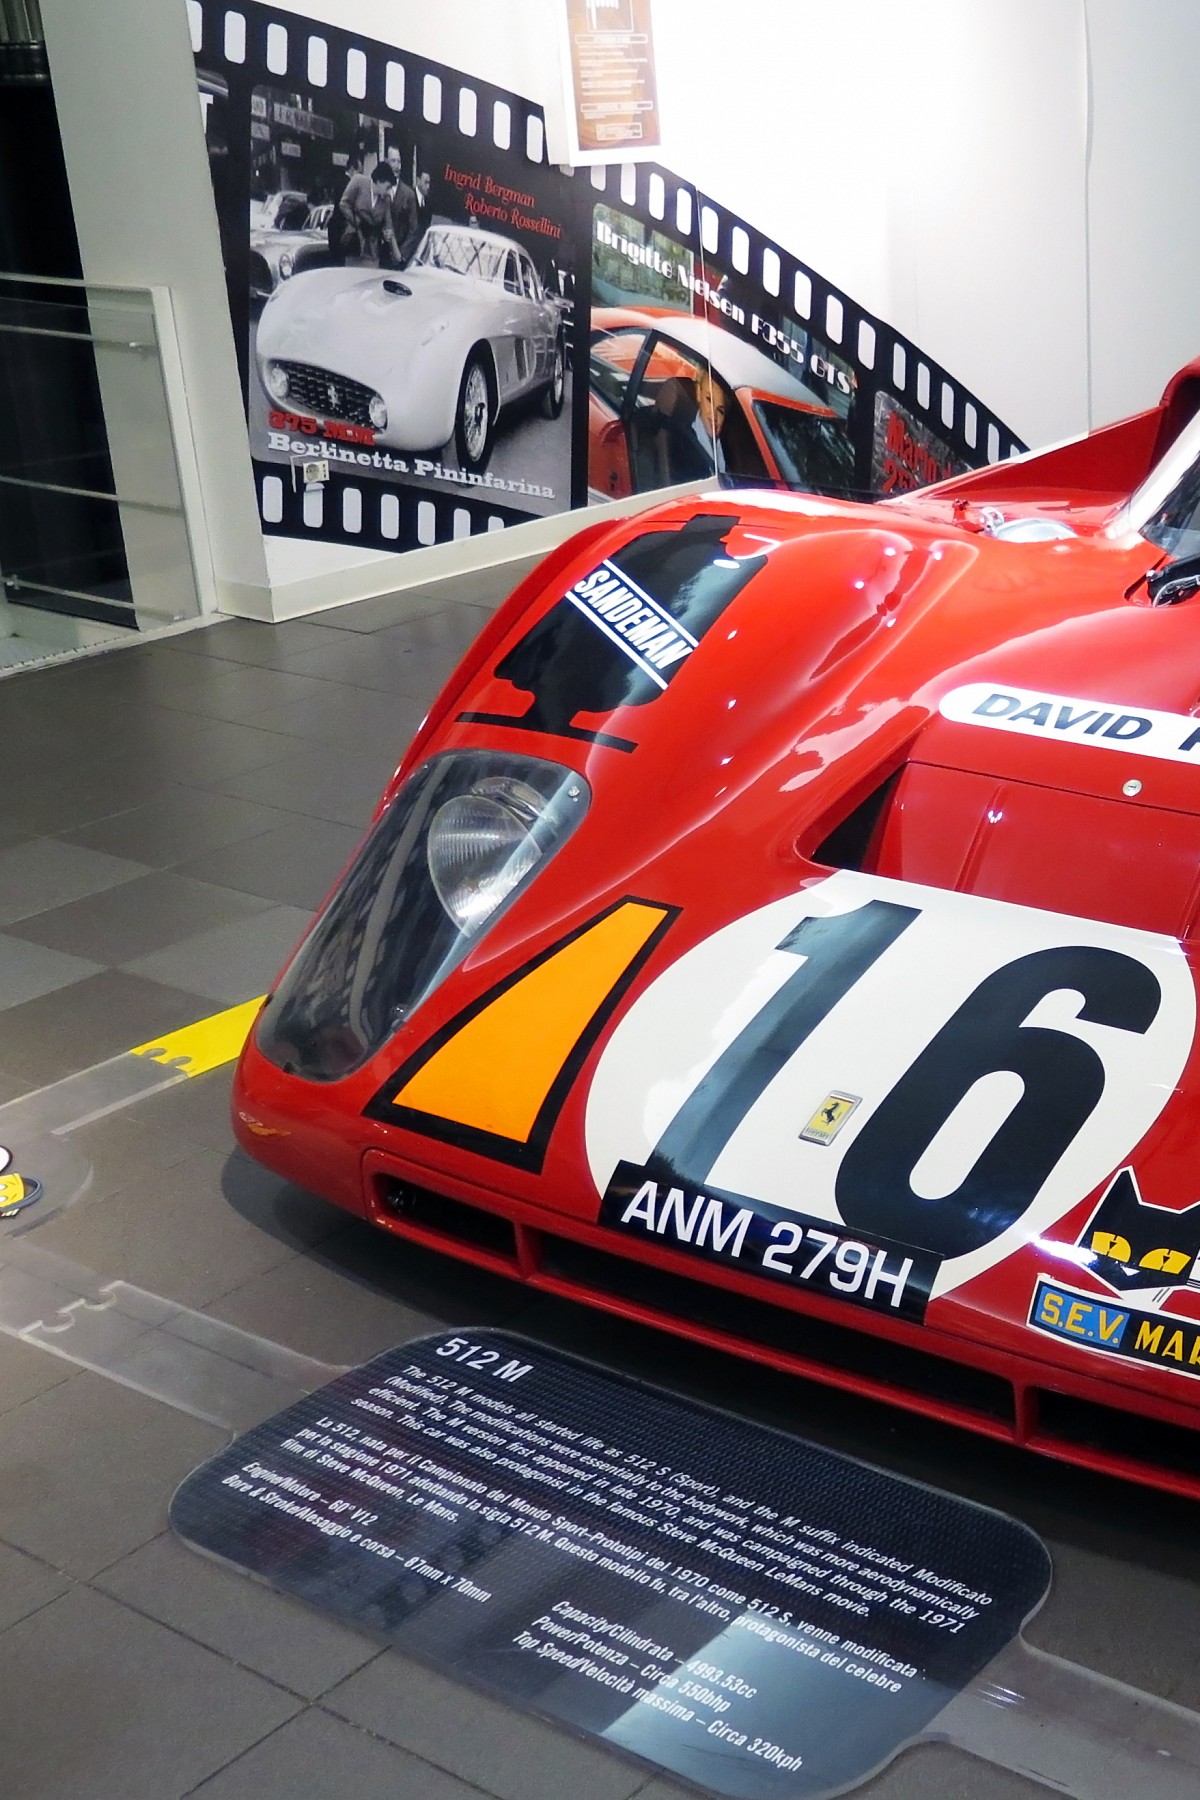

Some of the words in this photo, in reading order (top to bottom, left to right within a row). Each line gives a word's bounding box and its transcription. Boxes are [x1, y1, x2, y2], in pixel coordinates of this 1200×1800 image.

[444, 164, 481, 190] Ingrid
[485, 175, 535, 208] Bergman
[465, 192, 507, 221] Roberto
[511, 207, 561, 239] Rossellini
[597, 221, 674, 278] Brigitte
[677, 264, 745, 326] Nielsen
[751, 314, 805, 364] F355
[267, 432, 410, 474] Berlinetta
[413, 458, 556, 500] Pininfarina
[323, 421, 377, 446] MM
[573, 569, 695, 670] SANDEMAN
[973, 693, 1154, 741] DAVID
[650, 900, 1162, 1261] 16
[621, 1180, 756, 1260] ANM
[762, 1220, 914, 1308] 279H
[434, 1336, 499, 1369] 512
[491, 1358, 533, 1382] M
[1041, 1292, 1121, 1344] S.E.V.
[279, 1437, 305, 1453] film
[301, 1448, 321, 1459] di
[315, 1452, 350, 1473] Steve
[347, 1466, 405, 1499] McQueen,
[404, 1491, 424, 1505] Le
[349, 1397, 393, 1419] season.
[395, 1413, 425, 1429] This
[421, 1426, 446, 1438] car
[443, 1434, 471, 1448] was
[466, 1445, 497, 1459] also
[491, 1456, 570, 1489] protagonist
[564, 1483, 583, 1496] in
[581, 1490, 607, 1505] the
[604, 1500, 658, 1526] famous
[655, 1521, 697, 1543] Steve
[695, 1537, 765, 1571] McQueen
[763, 1565, 823, 1595] LeMans
[821, 1591, 869, 1616] movie.
[349, 1507, 378, 1525] V12
[367, 1386, 420, 1411] efficient.
[420, 1405, 447, 1421] The
[444, 1416, 465, 1427] M
[460, 1423, 507, 1445] version
[504, 1440, 536, 1457] first
[530, 1453, 597, 1481] appeared
[591, 1475, 610, 1488] in
[608, 1482, 638, 1499] late
[637, 1494, 680, 1519] 1970,
[680, 1514, 715, 1530] and
[711, 1525, 741, 1542] was
[740, 1538, 832, 1578] campaigned
[828, 1572, 888, 1602] through
[888, 1596, 916, 1613] the
[917, 1609, 965, 1633] 1971
[401, 1363, 426, 1378] The
[424, 1374, 457, 1389] 512
[452, 1385, 473, 1396] M
[468, 1392, 516, 1414] models
[513, 1411, 538, 1422] all
[532, 1418, 583, 1440] started
[578, 1435, 604, 1449] life
[622, 1453, 657, 1470] 512
[654, 1465, 671, 1475] S
[667, 1471, 720, 1498] (Sport),
[720, 1493, 755, 1509] and
[752, 1504, 778, 1519] the
[778, 1515, 801, 1527] M
[797, 1524, 840, 1544] suffix
[840, 1539, 914, 1572] indicated
[911, 1567, 992, 1604] Modificato
[446, 1398, 473, 1414] The
[467, 1409, 552, 1446] modifications
[548, 1441, 581, 1458] were
[578, 1454, 649, 1486] essentially
[644, 1479, 662, 1491] to
[659, 1485, 685, 1500] the
[681, 1494, 749, 1529] bodywork,
[750, 1522, 794, 1545] which
[792, 1539, 823, 1556] was
[819, 1551, 859, 1571] more
[856, 1566, 979, 1619] aerodynamically
[220, 1473, 253, 1492] Bore
[358, 1537, 395, 1558] corsa
[403, 1555, 444, 1580] 87mm
[449, 1576, 491, 1602] 70mm
[293, 1427, 321, 1441] per
[315, 1434, 332, 1446] la
[328, 1441, 380, 1466] stagione
[377, 1460, 413, 1479] 1971
[406, 1475, 468, 1504] adottando
[464, 1497, 481, 1510] la
[477, 1505, 511, 1524] sigla
[507, 1516, 540, 1535] 512
[552, 1536, 599, 1561] Questo
[594, 1555, 651, 1583] modello
[647, 1576, 666, 1593] fu,
[666, 1585, 689, 1601] tra
[730, 1614, 820, 1657] protagonista
[818, 1651, 848, 1668] del
[843, 1662, 901, 1692] celebre
[314, 1415, 333, 1428] La
[330, 1421, 360, 1441] 512,
[357, 1435, 387, 1451] nata
[381, 1446, 410, 1459] per
[416, 1458, 487, 1493] Campionato
[485, 1488, 512, 1503] del
[506, 1496, 551, 1520] Mondo
[643, 1555, 671, 1571] del
[669, 1565, 709, 1587] 1970
[706, 1582, 746, 1604] come
[745, 1597, 779, 1615] 512
[777, 1610, 793, 1626] S,
[796, 1619, 840, 1644] venne
[839, 1639, 917, 1677] modificata
[511, 1629, 540, 1649] Top
[629, 1685, 694, 1721] massima
[706, 1719, 747, 1746] Circa
[745, 1737, 802, 1771] 320kph
[639, 1662, 674, 1684] Circa
[677, 1680, 731, 1712] 550bhp
[686, 1659, 757, 1698] 4993.53cc
